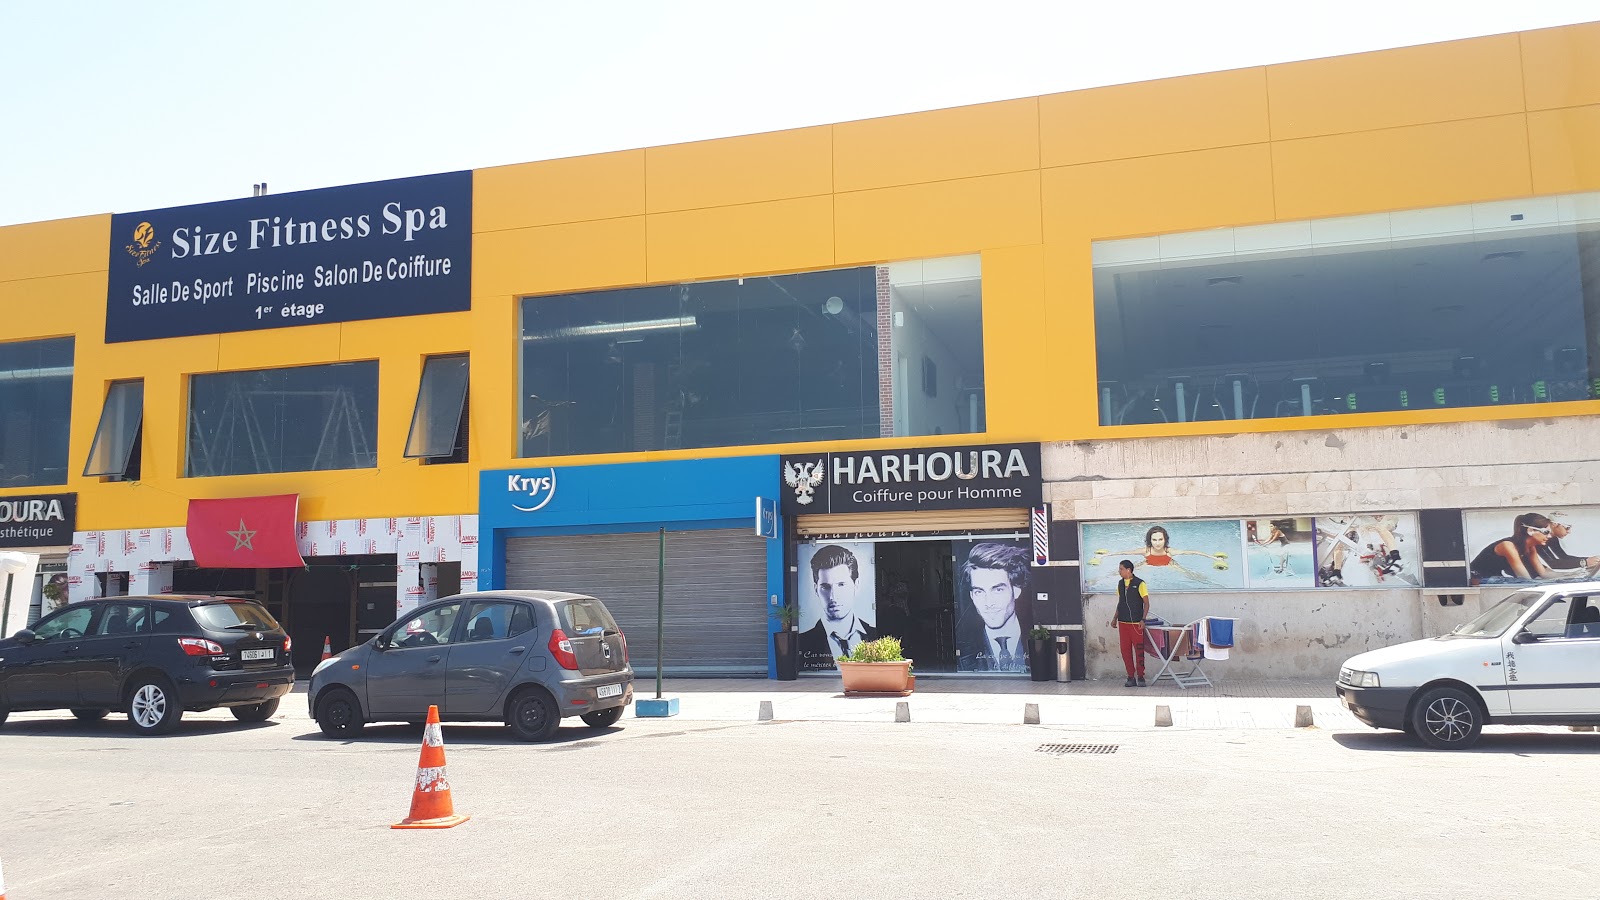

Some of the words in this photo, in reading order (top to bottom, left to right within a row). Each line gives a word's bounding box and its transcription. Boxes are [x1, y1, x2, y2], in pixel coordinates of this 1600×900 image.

[171, 225, 238, 259] Size
[247, 214, 371, 250] Fitness
[382, 201, 448, 241] Spa
[132, 283, 168, 306] Salle
[171, 281, 190, 302] De
[193, 276, 234, 304] Sport
[246, 269, 304, 295] Piscine
[314, 263, 358, 288] Salon
[362, 260, 383, 283] De
[386, 254, 451, 280] Coiffure
[281, 303, 325, 319] étage
[833, 448, 1030, 485] HARHOURA
[508, 474, 551, 496] Krys
[852, 488, 913, 503] Coiffure
[918, 490, 954, 504] pour
[957, 486, 1022, 499] Homme
[0, 499, 65, 522] OURA
[0, 526, 54, 540] sthétique
